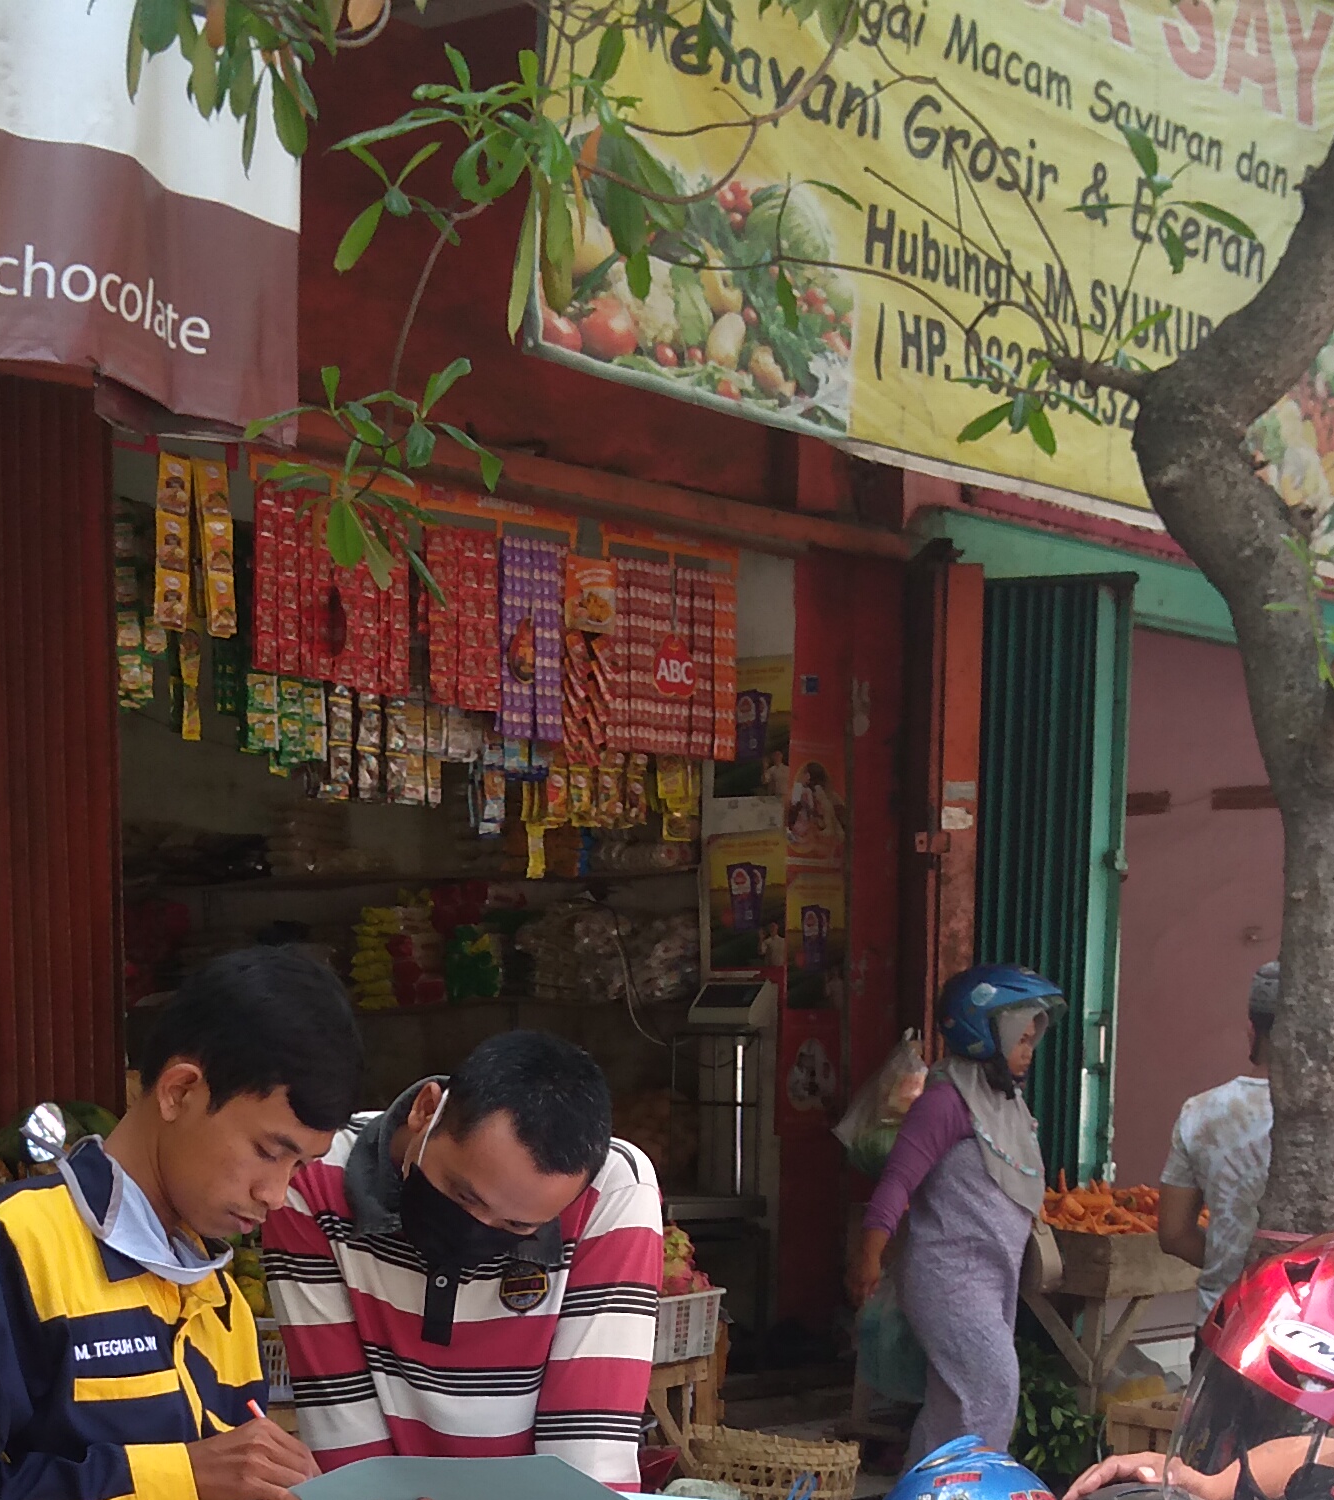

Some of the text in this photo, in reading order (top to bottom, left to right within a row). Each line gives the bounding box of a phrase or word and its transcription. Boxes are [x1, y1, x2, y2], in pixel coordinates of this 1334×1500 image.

[943, 12, 1074, 111] Macam
[1235, 141, 1290, 198] dan
[903, 94, 1059, 203] Grosir
[1080, 162, 1111, 227] &
[656, 658, 694, 686] ABC
[93, 1338, 134, 1358] TEGUH
